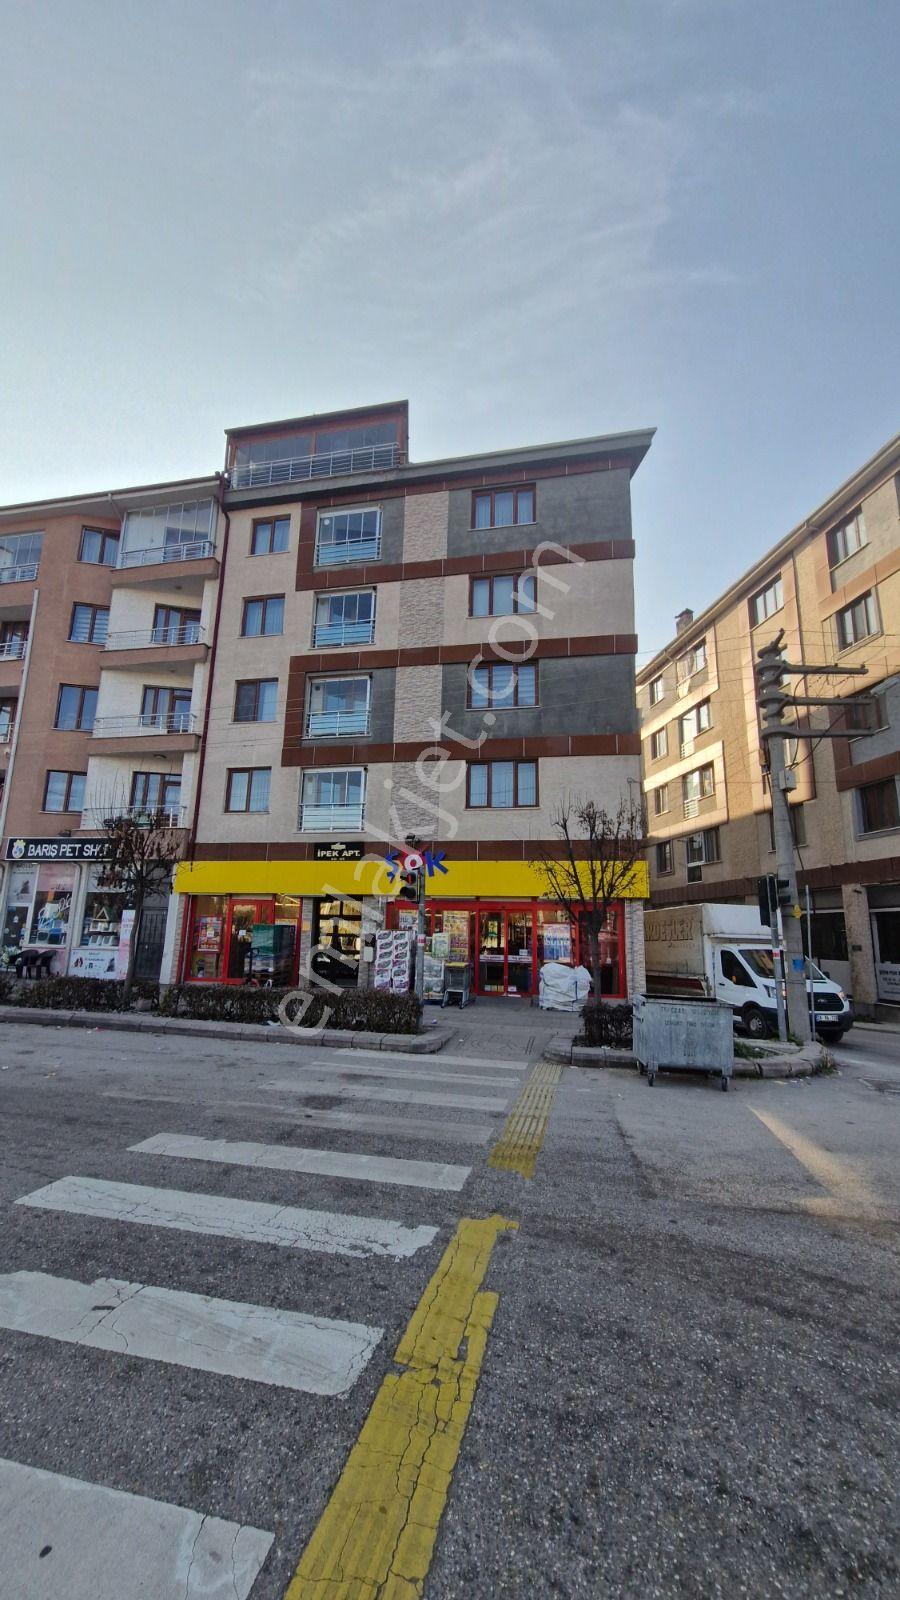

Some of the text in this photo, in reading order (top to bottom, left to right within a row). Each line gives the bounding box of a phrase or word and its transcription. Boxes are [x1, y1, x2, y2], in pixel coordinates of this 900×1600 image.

[28, 844, 58, 858] BARIŞ
[59, 844, 81, 856] PET
[317, 848, 339, 858] İPEK
